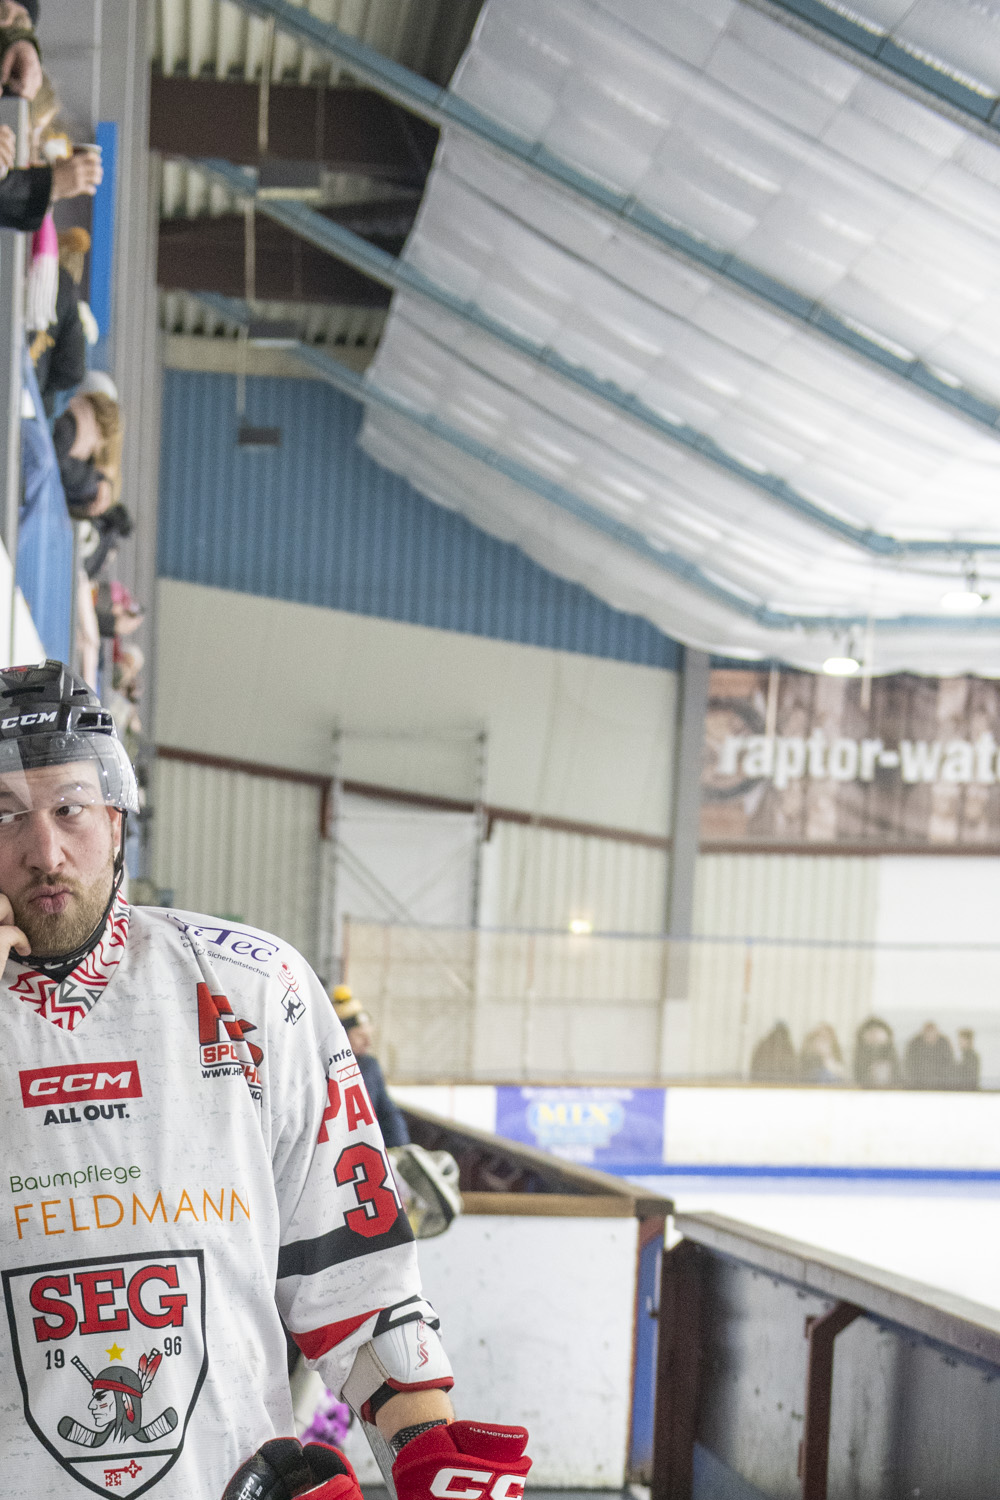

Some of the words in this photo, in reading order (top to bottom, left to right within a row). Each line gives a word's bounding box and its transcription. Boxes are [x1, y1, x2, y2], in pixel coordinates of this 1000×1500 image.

[0, 710, 58, 730] CCM
[716, 728, 1000, 791] raptor-wat
[28, 1070, 132, 1097] CCM
[43, 1107, 82, 1126] ALL
[83, 1103, 130, 1121] OUT.
[9, 1164, 142, 1193] Baumpflege
[14, 1187, 251, 1240] FELDMANN
[29, 1264, 188, 1343] SEG
[45, 1348, 66, 1370] 19
[163, 1336, 182, 1357] 96
